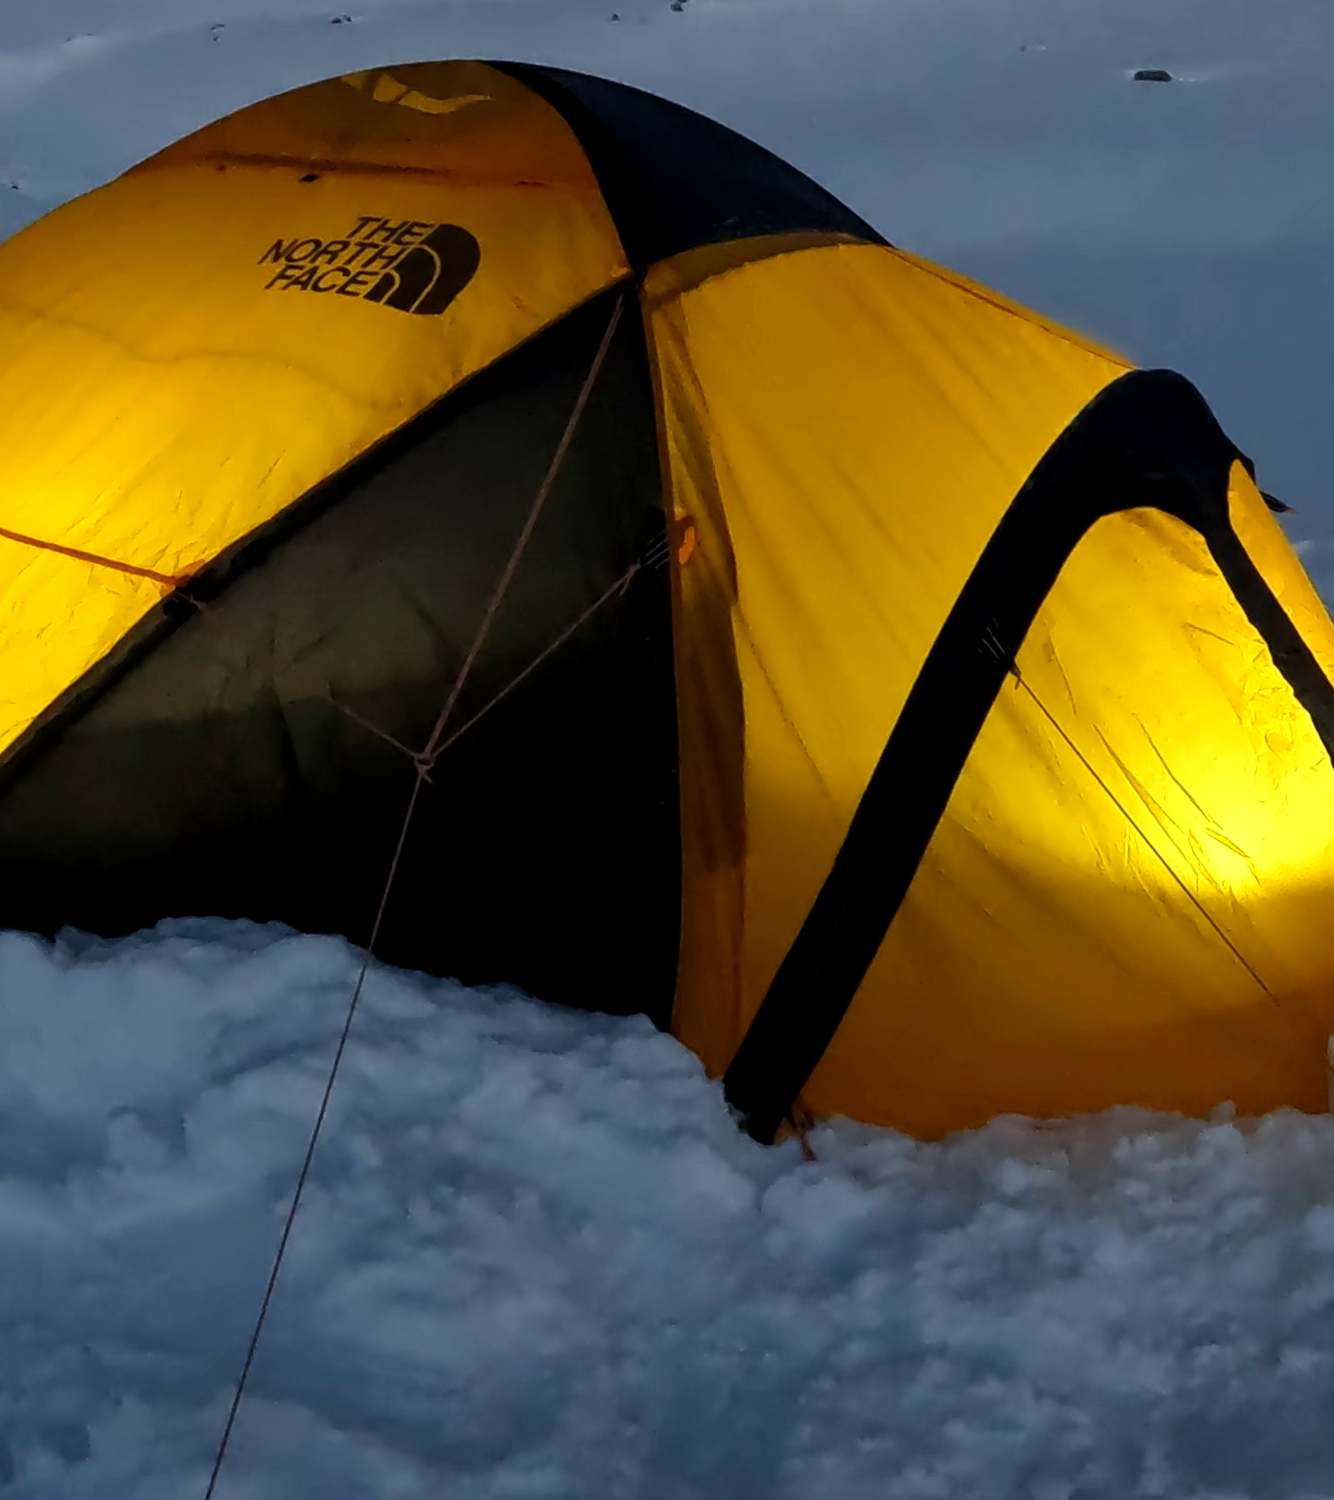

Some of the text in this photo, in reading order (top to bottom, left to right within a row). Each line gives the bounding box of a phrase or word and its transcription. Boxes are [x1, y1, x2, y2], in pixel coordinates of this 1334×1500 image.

[346, 216, 435, 245] THE
[257, 238, 410, 270] NORTH
[264, 265, 379, 297] FACE
